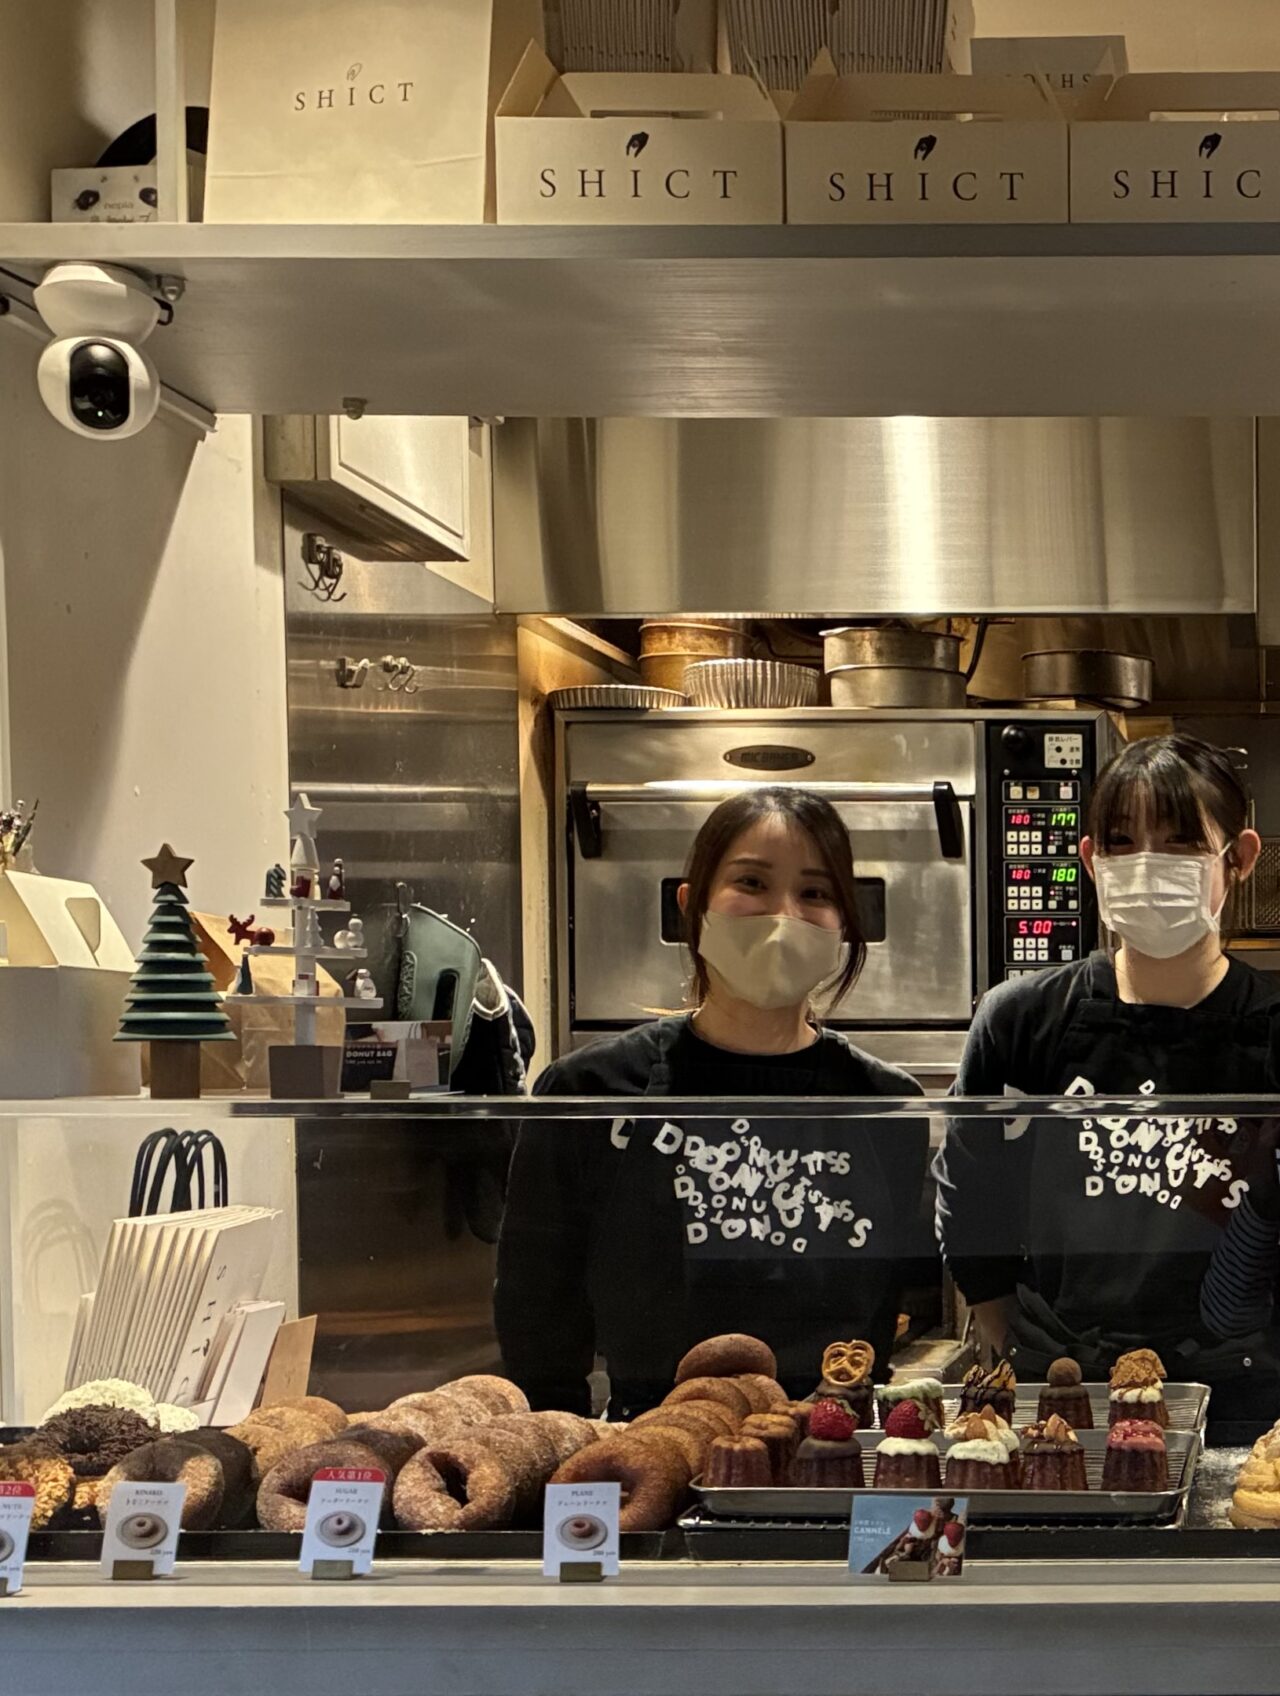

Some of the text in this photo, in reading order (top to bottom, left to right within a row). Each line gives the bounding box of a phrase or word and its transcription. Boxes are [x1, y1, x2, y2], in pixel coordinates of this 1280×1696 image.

[294, 81, 414, 111] SHICT
[540, 168, 738, 199] SHICT
[828, 171, 1024, 202] SHICT
[1051, 813, 1077, 826] 177
[1011, 869, 1032, 880] 180
[1052, 868, 1077, 882] 180
[345, 1050, 375, 1058] DONUT
